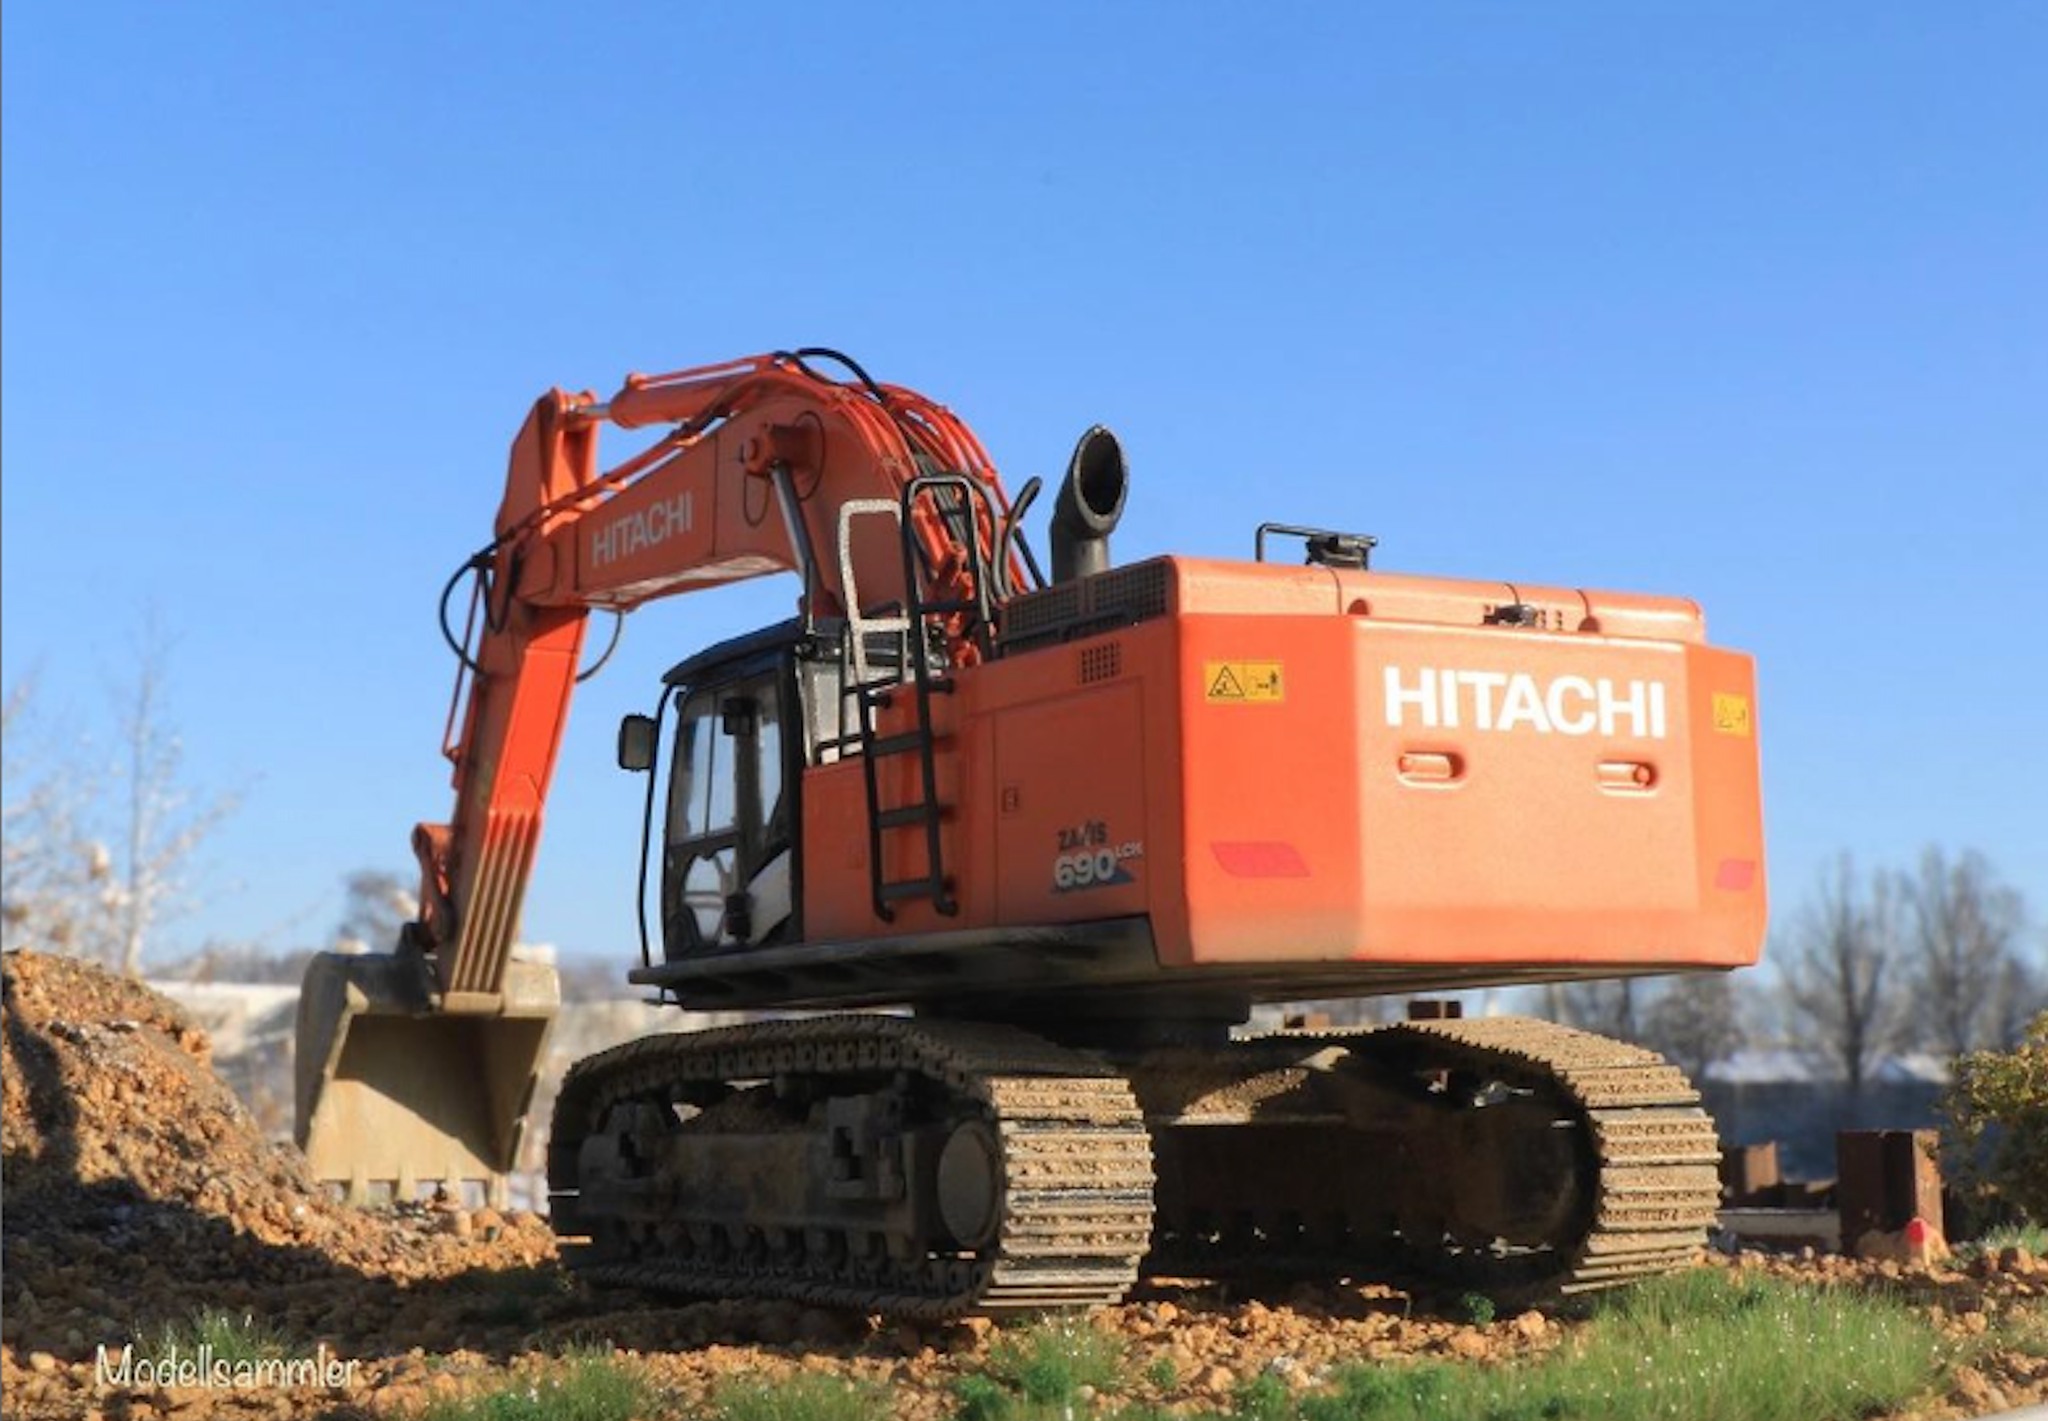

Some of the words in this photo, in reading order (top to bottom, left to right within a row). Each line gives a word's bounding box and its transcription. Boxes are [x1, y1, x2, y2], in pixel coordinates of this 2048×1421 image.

[591, 490, 694, 568] HITACHI
[1383, 665, 1665, 739] HITACHI
[1055, 848, 1116, 888] 690
